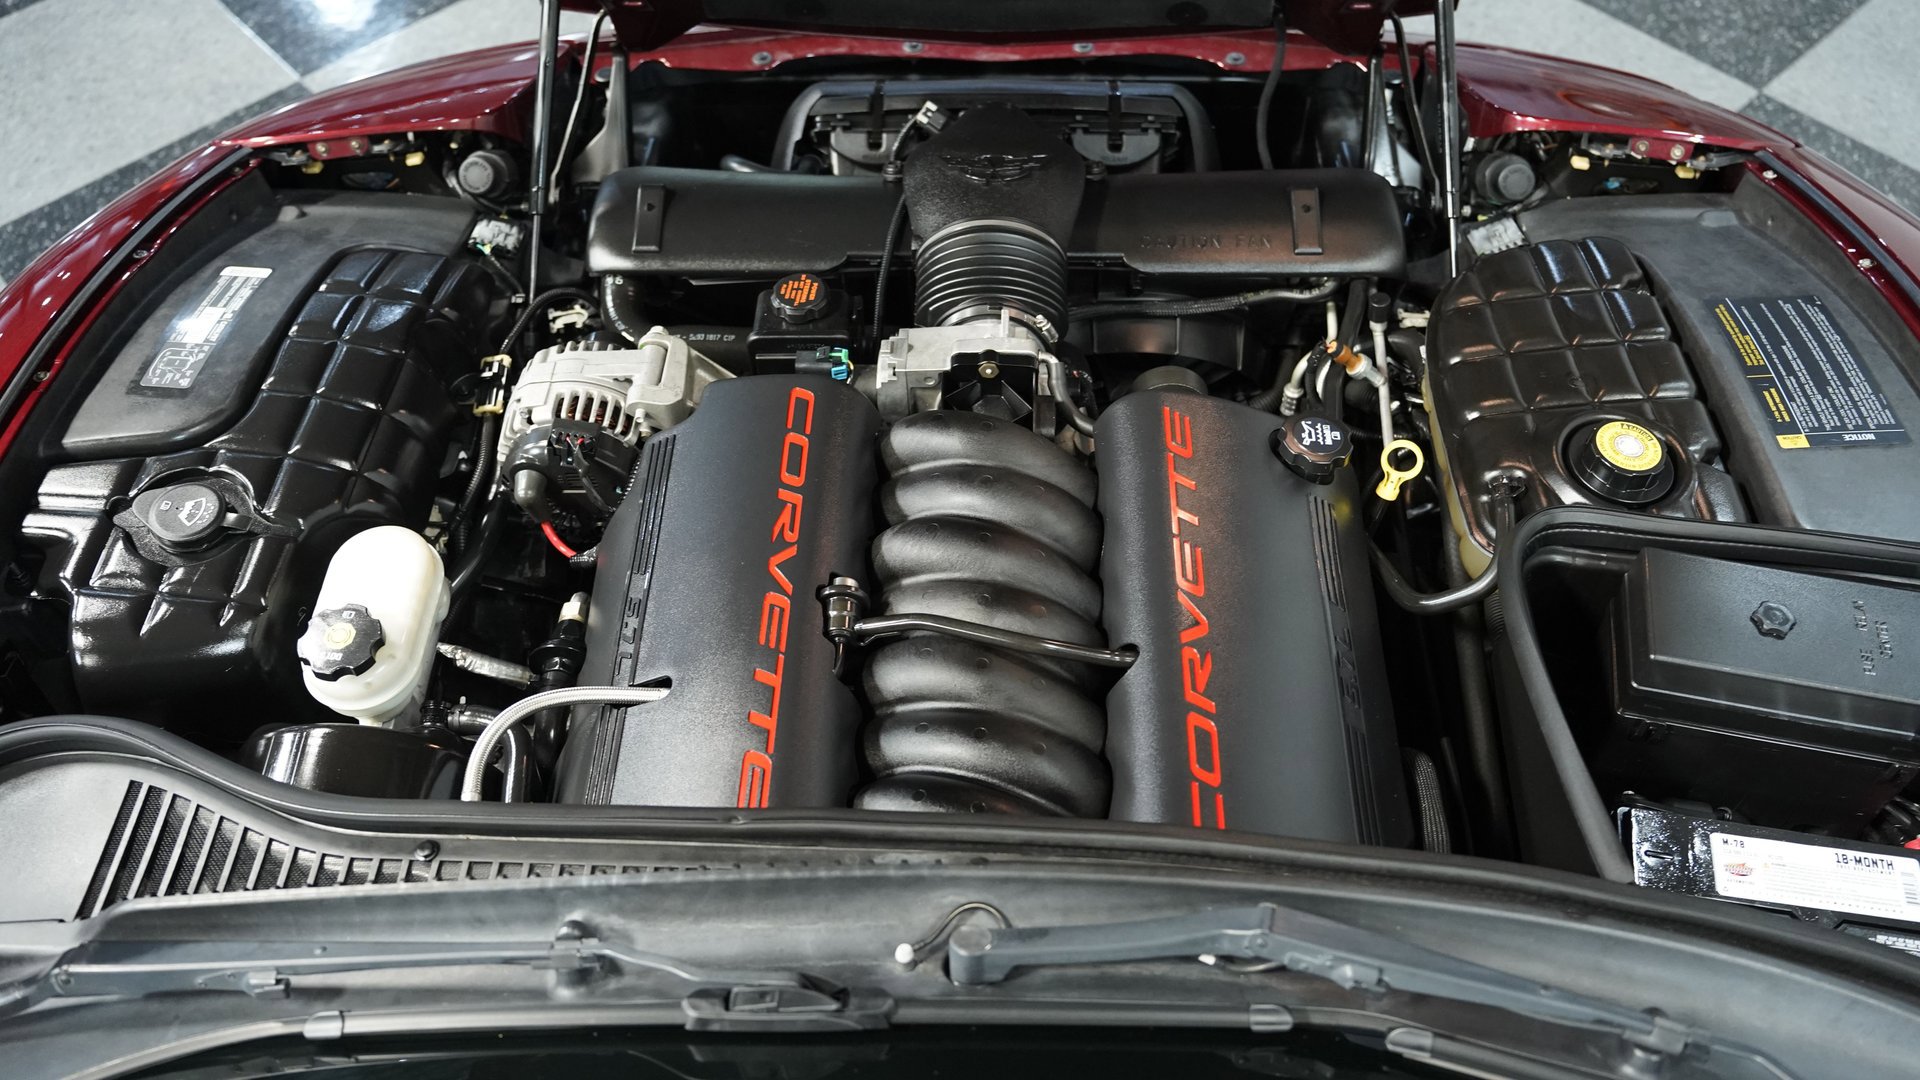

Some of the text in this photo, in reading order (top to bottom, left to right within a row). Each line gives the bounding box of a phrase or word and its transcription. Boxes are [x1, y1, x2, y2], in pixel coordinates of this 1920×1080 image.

[1139, 234, 1272, 249] CAUTION FAN
[1841, 433, 1876, 442] NOTICE
[738, 386, 815, 808] CORVETTE
[1163, 405, 1225, 829] CORVETTE
[614, 596, 642, 676] 5.7L
[1860, 648, 1876, 676] FUSE
[1835, 852, 1894, 870] 18-MONTH
